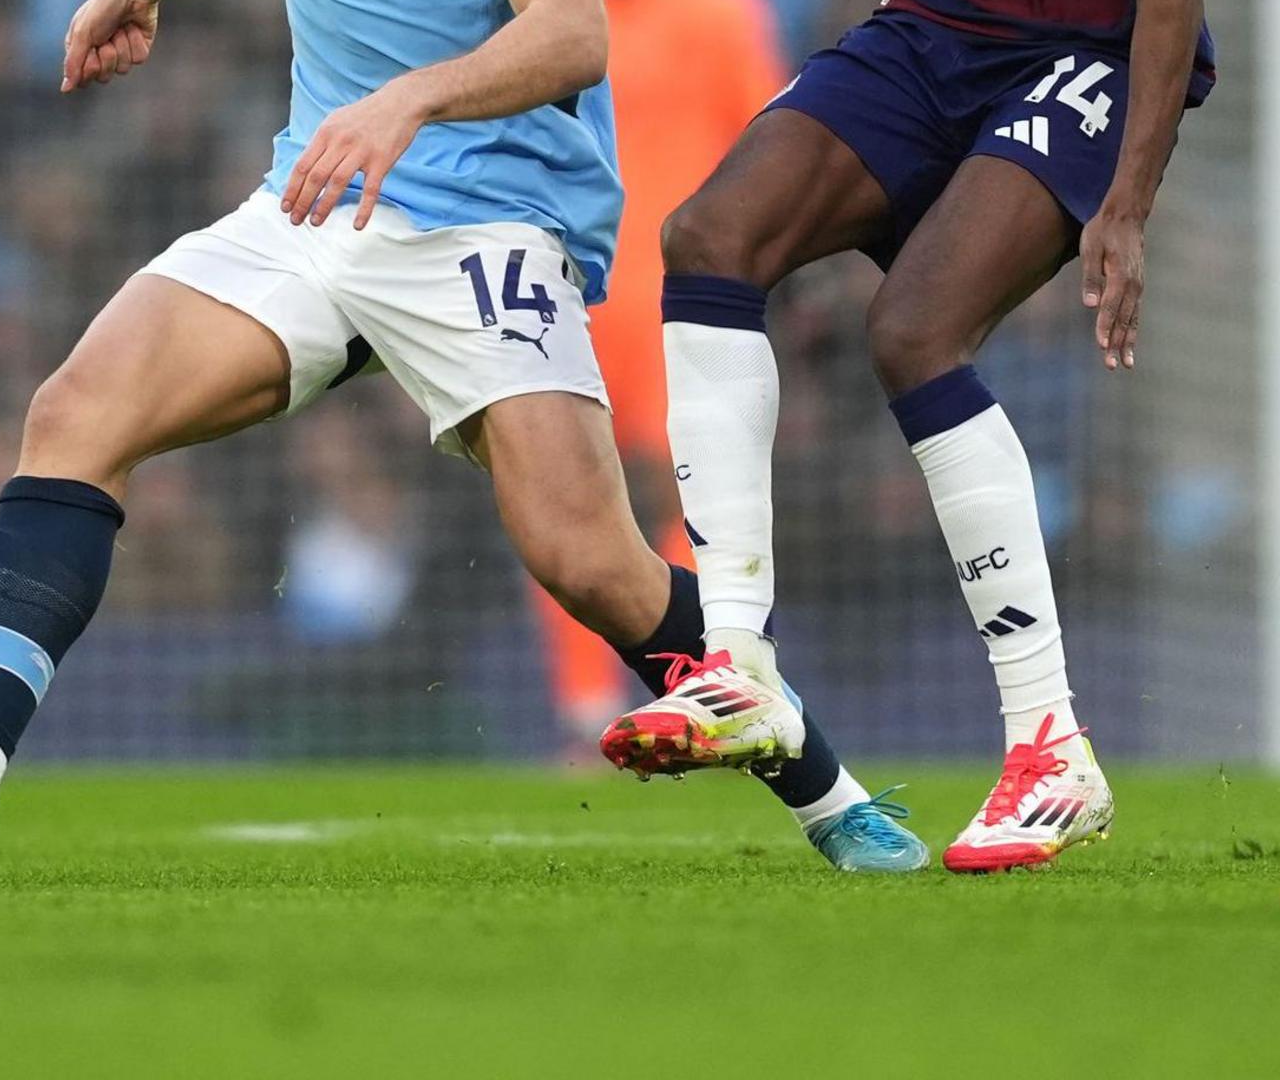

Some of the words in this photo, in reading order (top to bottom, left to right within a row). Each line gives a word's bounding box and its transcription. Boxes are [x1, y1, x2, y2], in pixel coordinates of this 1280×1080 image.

[1024, 55, 1114, 138] 14
[459, 249, 558, 328] 14
[958, 547, 1010, 582] UFC
